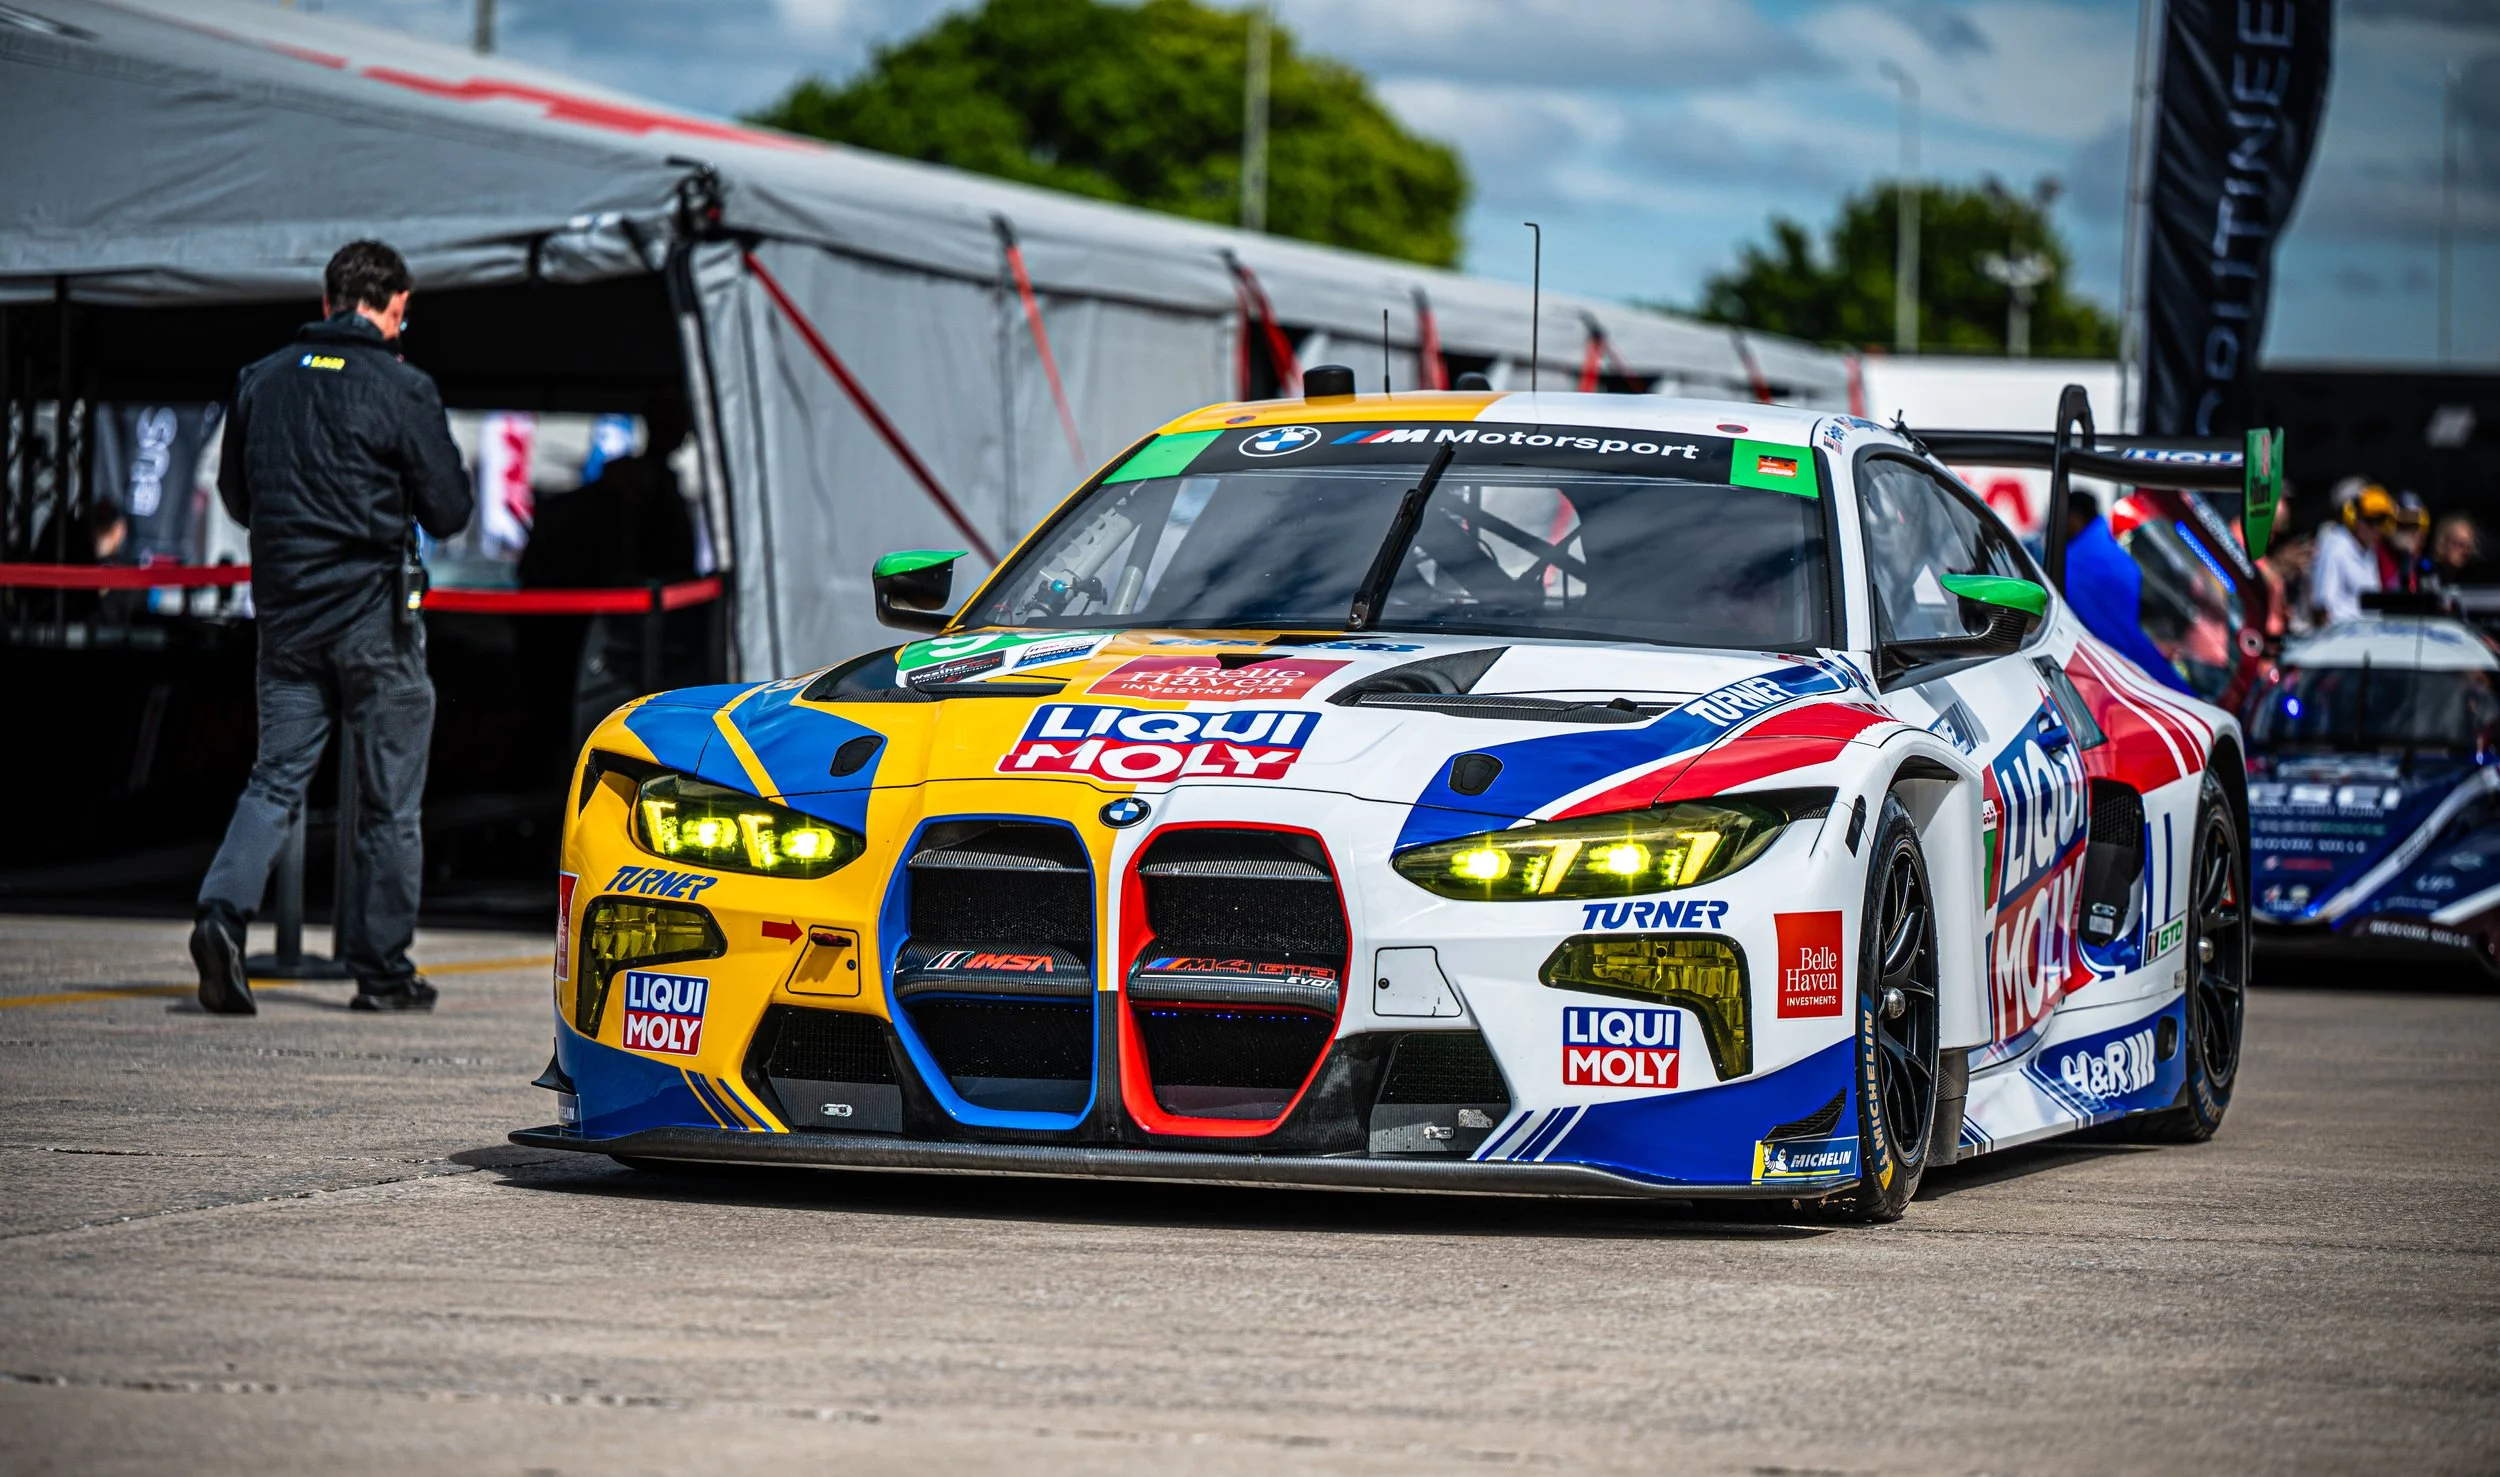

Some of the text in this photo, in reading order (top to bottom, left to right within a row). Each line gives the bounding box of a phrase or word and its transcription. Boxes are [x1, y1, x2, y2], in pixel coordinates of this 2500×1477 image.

[1434, 429, 1700, 459] Motorsport
[1125, 672, 1294, 688] Haven
[1181, 666, 1306, 678] Belle
[1121, 682, 1284, 696] INVESTMENTS
[1683, 677, 1800, 727] TURNER
[1038, 708, 1300, 745] LIQUI
[1015, 740, 1297, 780] MOLY
[604, 865, 718, 900] TURNER
[1582, 900, 1729, 929] TURNER
[1998, 848, 2085, 1042] MOLY
[2160, 919, 2184, 952] GTD
[964, 953, 1054, 973] IMSA
[1257, 963, 1336, 981] GT3
[1800, 946, 1837, 970] Belle
[629, 976, 704, 1013] LIQUI
[1286, 976, 1332, 989] EVO
[1785, 968, 1838, 992] Haven
[1786, 995, 1837, 1007] INVESTMENTS
[626, 1013, 701, 1051] MOLY
[1569, 1011, 1675, 1048] LIQUI
[1569, 1050, 1678, 1085] MOLY
[1864, 1010, 1885, 1151] MICHELIN
[1790, 1150, 1852, 1167] MICHELIN
